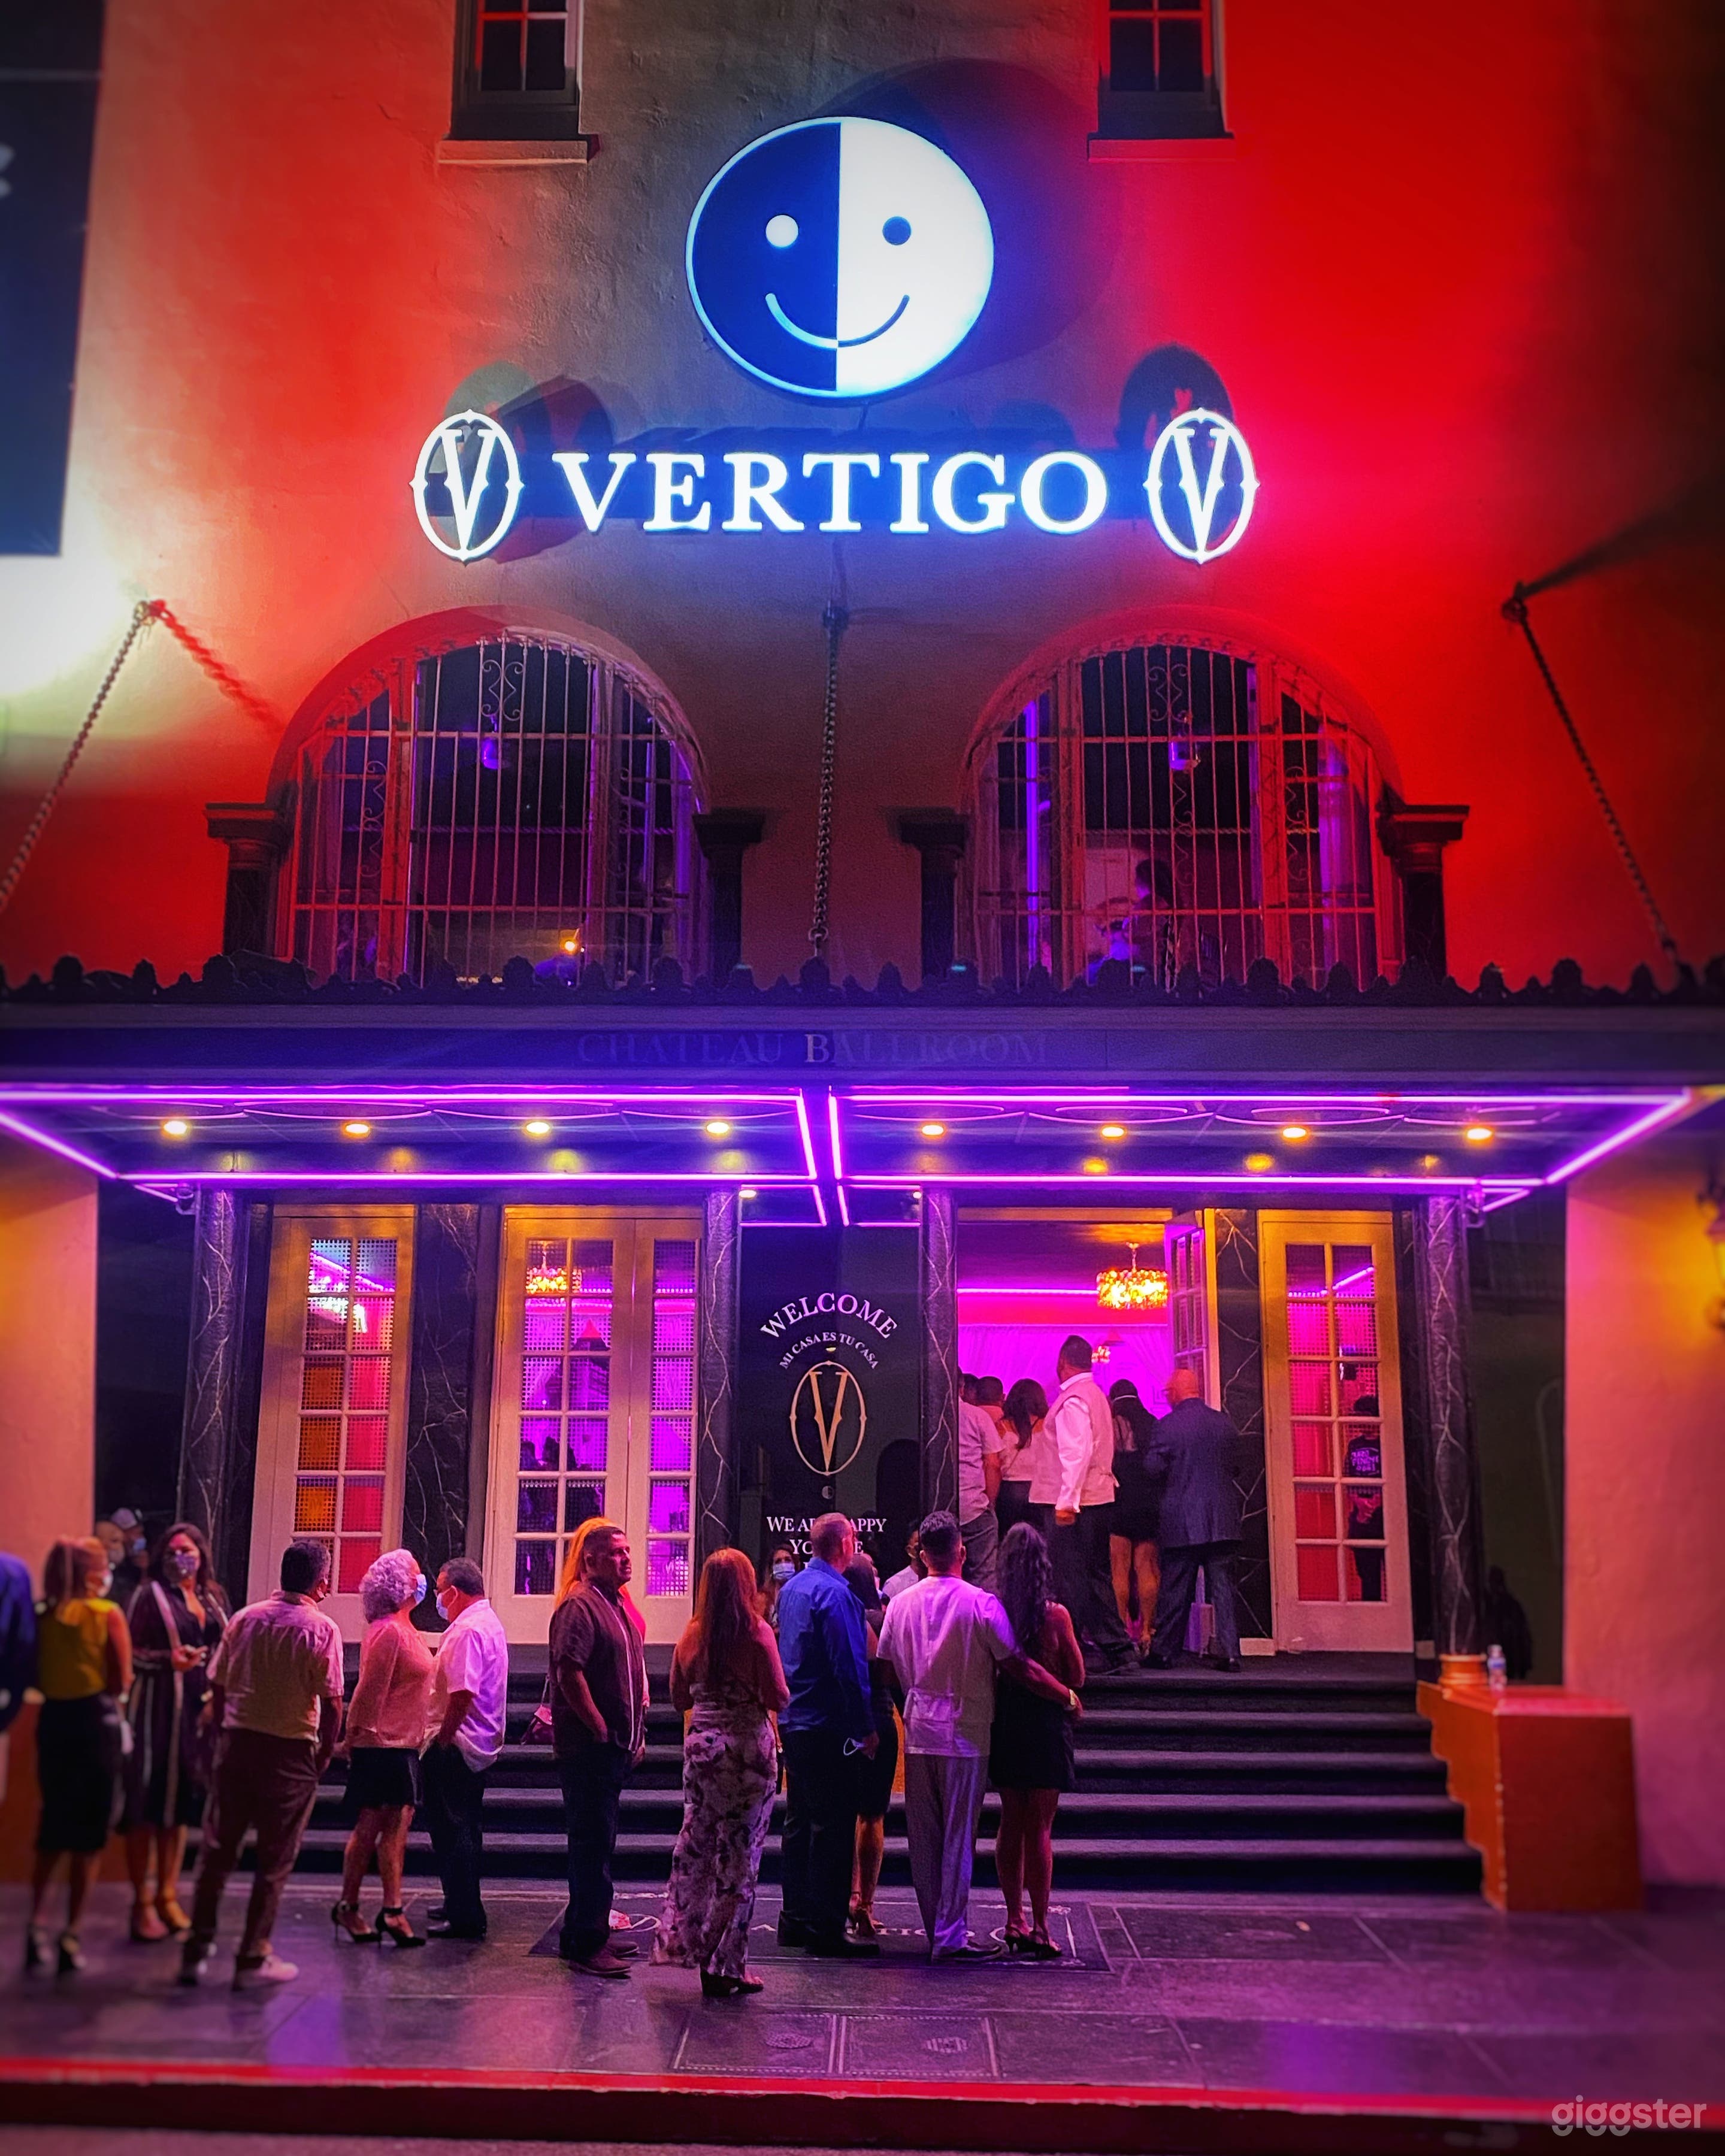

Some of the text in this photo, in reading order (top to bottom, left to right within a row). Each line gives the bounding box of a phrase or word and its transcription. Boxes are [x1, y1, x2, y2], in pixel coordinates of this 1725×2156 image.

[552, 452, 1107, 535] VERTIGO
[577, 1033, 1046, 1064] CHATEAU BALLROOM
[759, 1292, 897, 1339] WELCOME
[779, 1332, 879, 1370] MI CASA ES TU CASA
[767, 1516, 794, 1532] WE
[850, 1518, 886, 1532] APPY
[789, 1539, 813, 1555] YO
